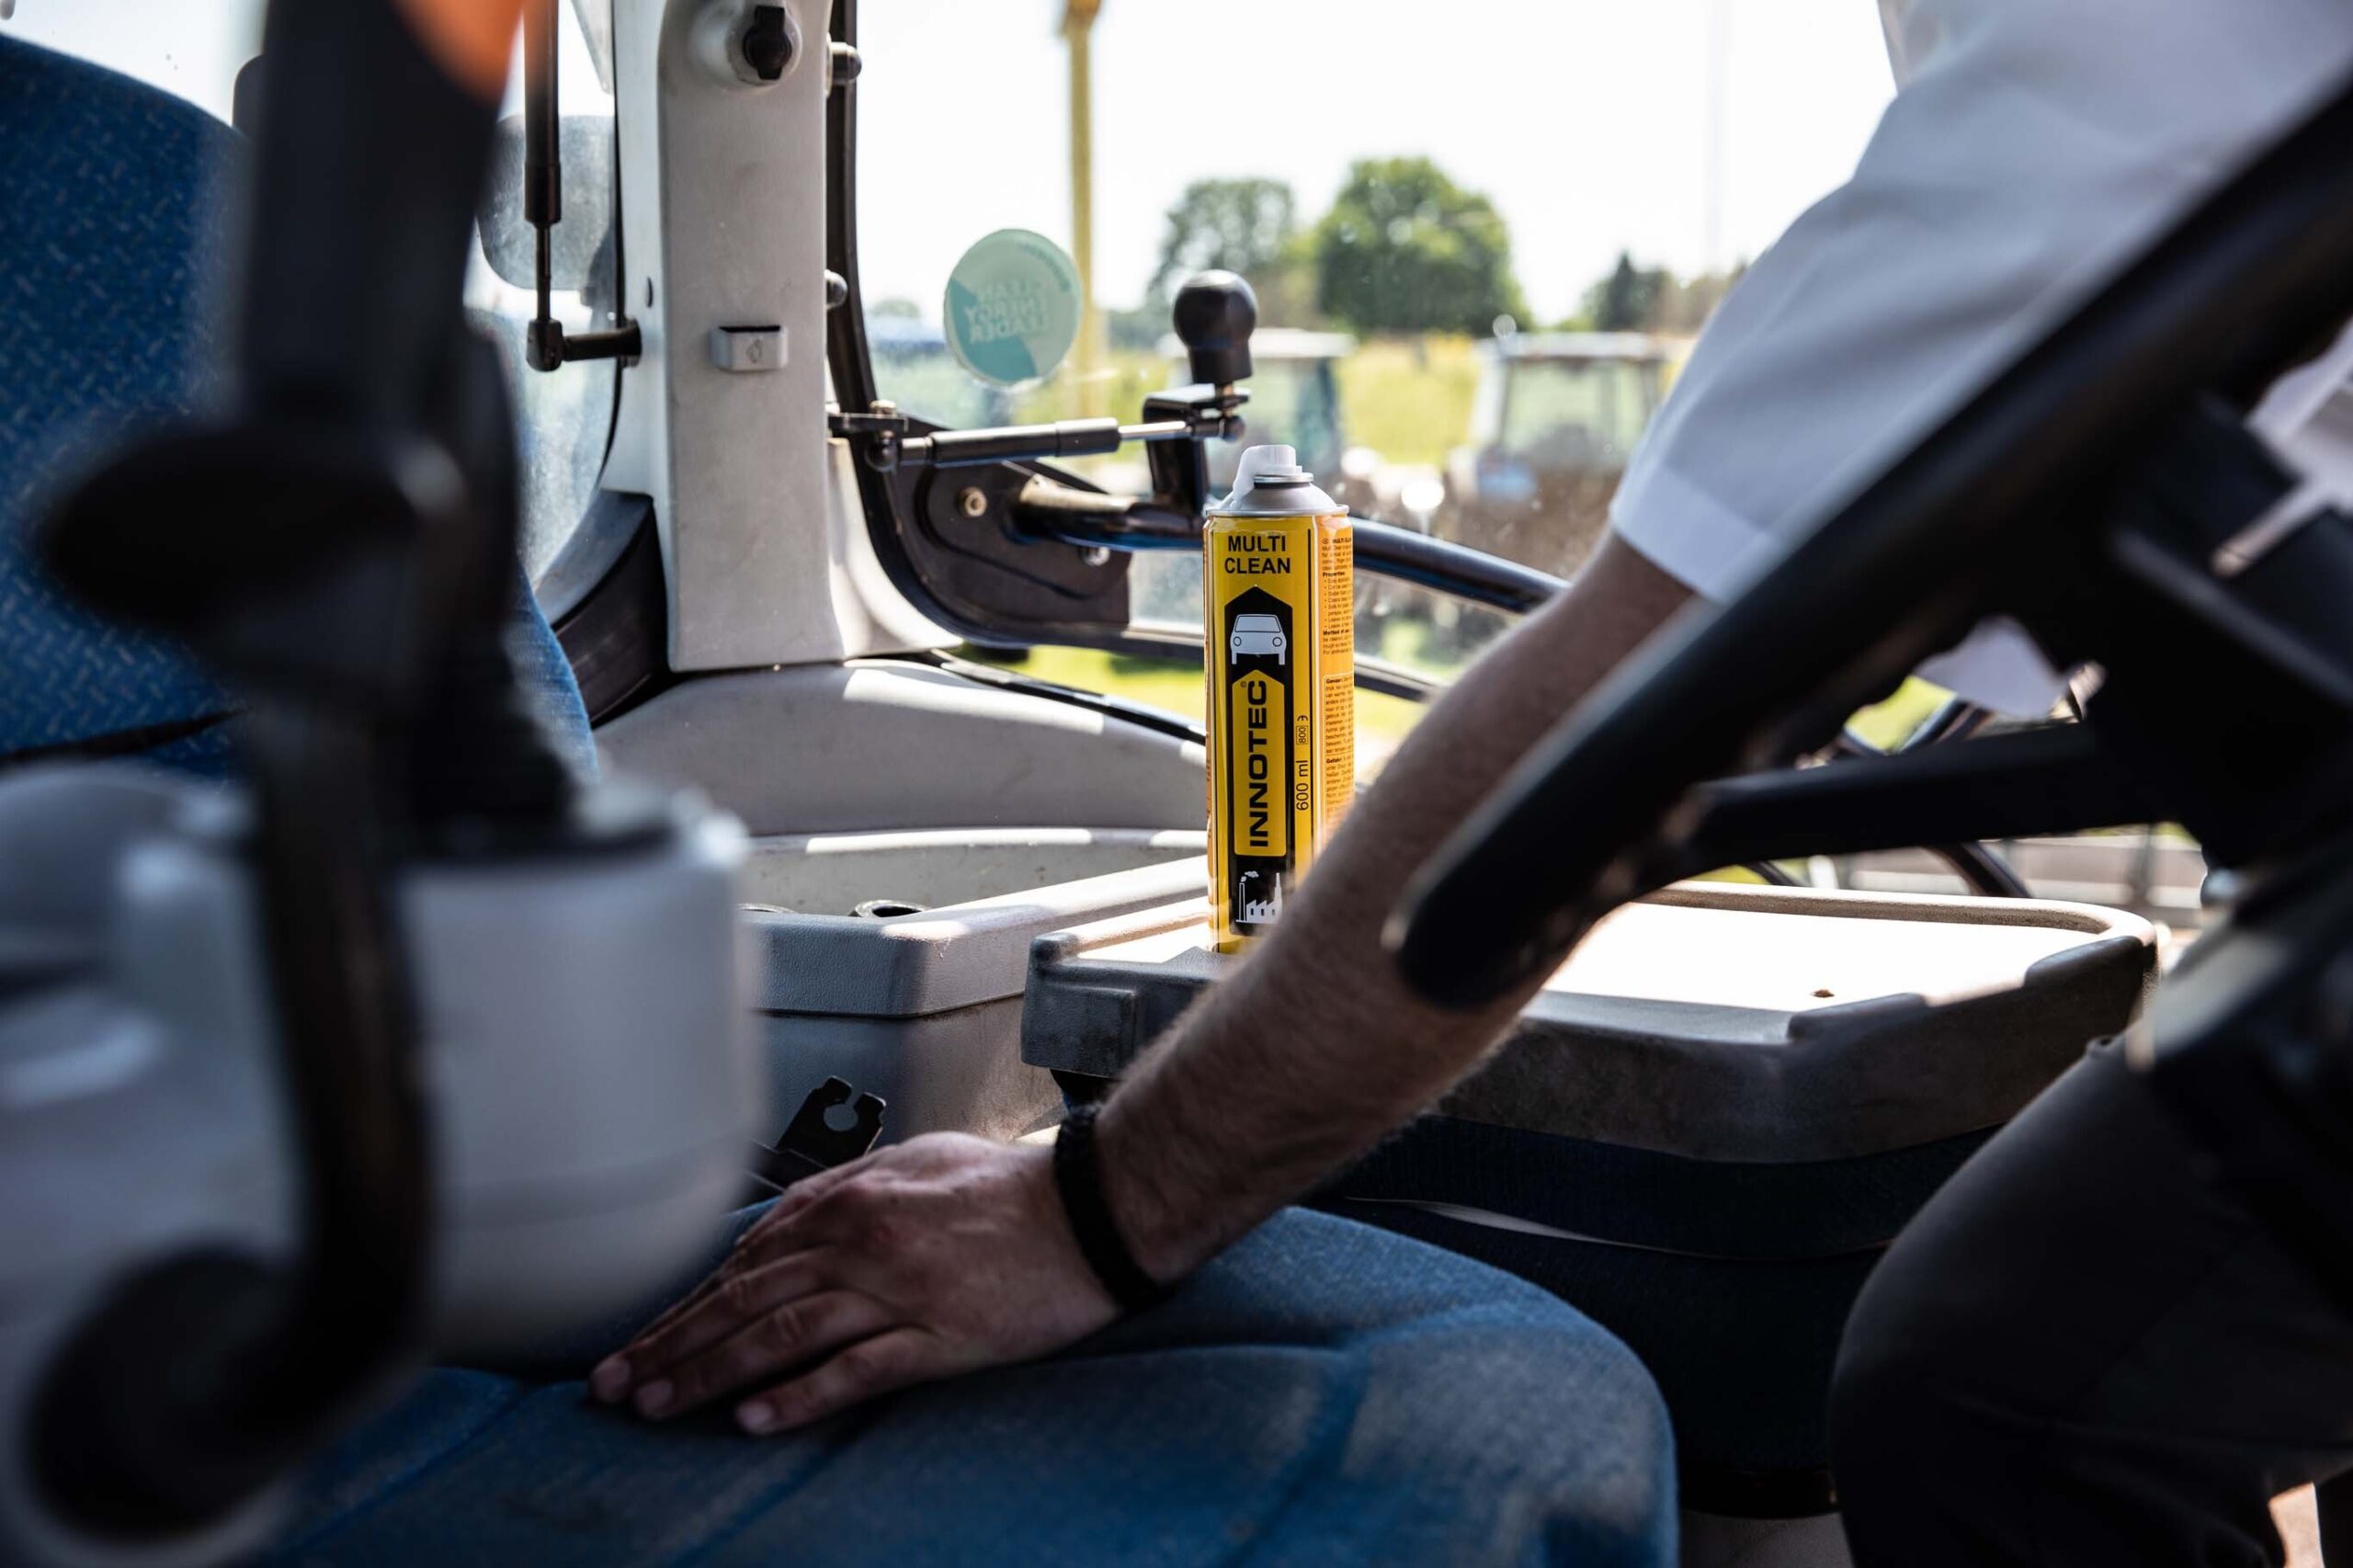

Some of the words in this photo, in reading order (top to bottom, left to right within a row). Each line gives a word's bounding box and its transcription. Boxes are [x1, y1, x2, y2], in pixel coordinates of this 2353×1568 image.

[1228, 535, 1286, 552] MULTI
[1224, 557, 1290, 574] CLEAN
[1298, 727, 1306, 744] 800
[1247, 679, 1268, 847] INNOTEC
[1295, 760, 1308, 777] ml
[1296, 783, 1309, 811] 600
